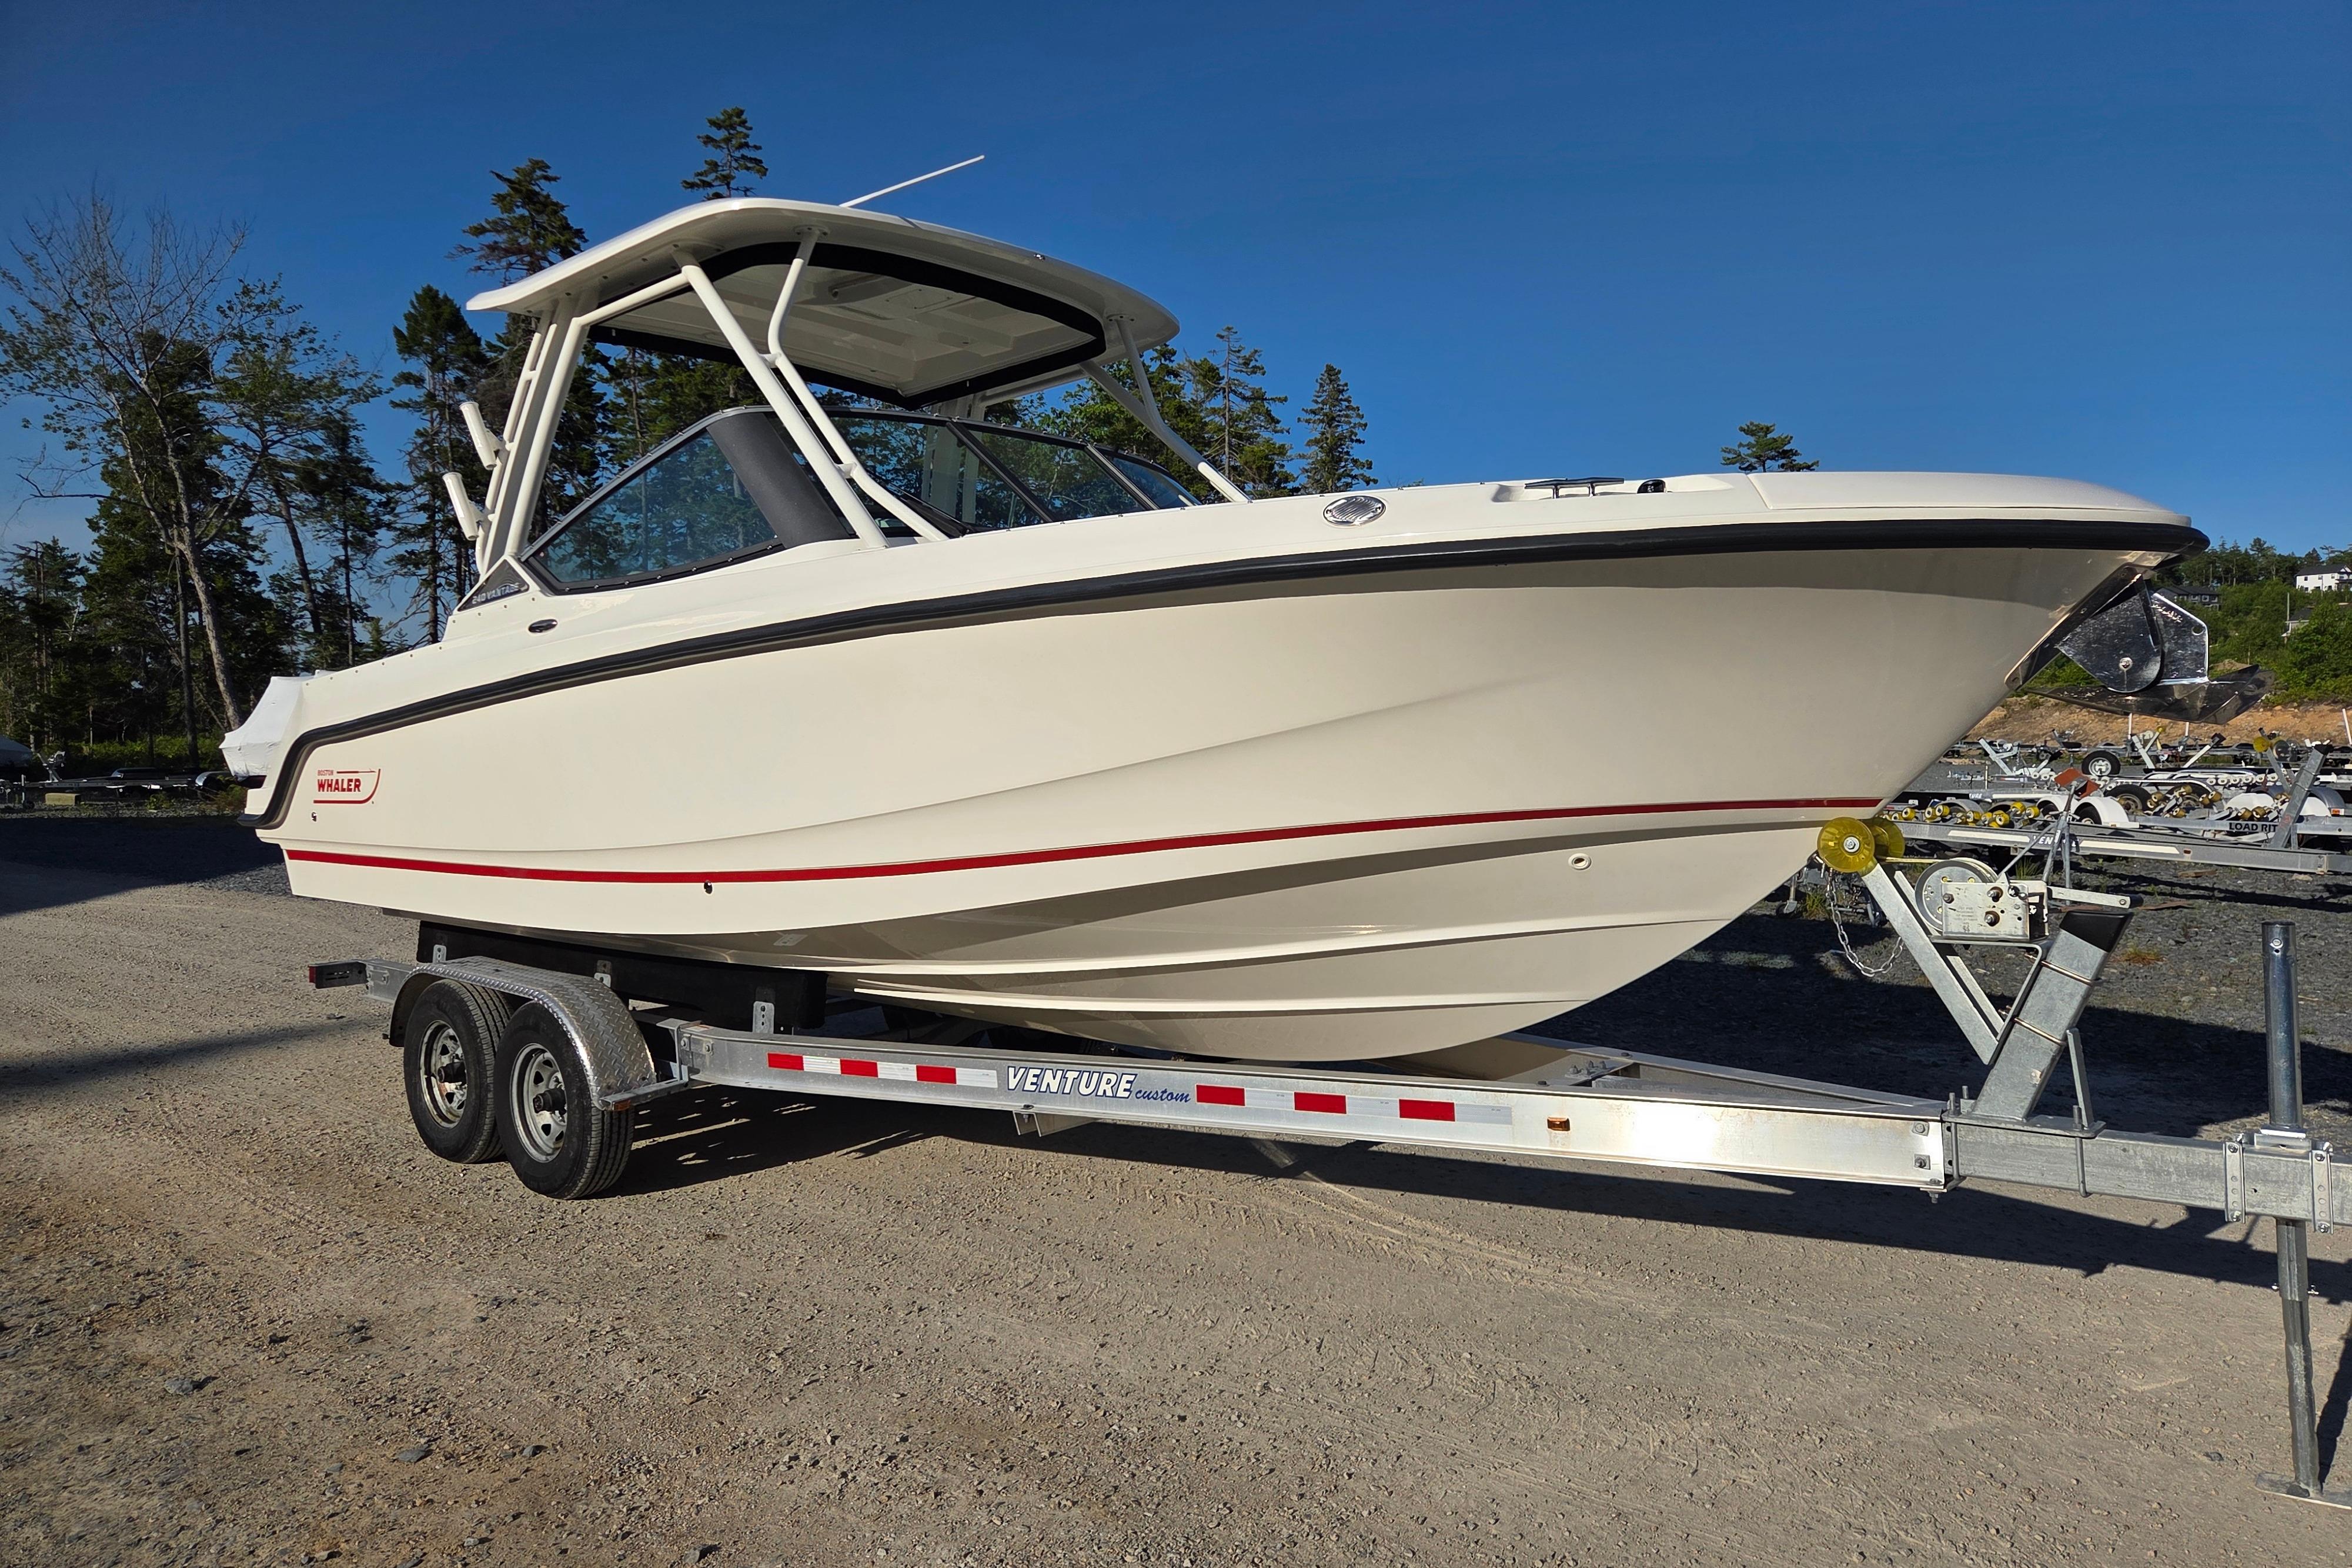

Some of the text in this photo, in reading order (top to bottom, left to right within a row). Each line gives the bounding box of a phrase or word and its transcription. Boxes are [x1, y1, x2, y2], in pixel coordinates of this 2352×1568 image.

[472, 593, 486, 604] 240
[318, 778, 362, 792] WHALER
[2229, 823, 2278, 833] LOAD RIT
[1007, 1065, 1191, 1103] VENTURE custom
